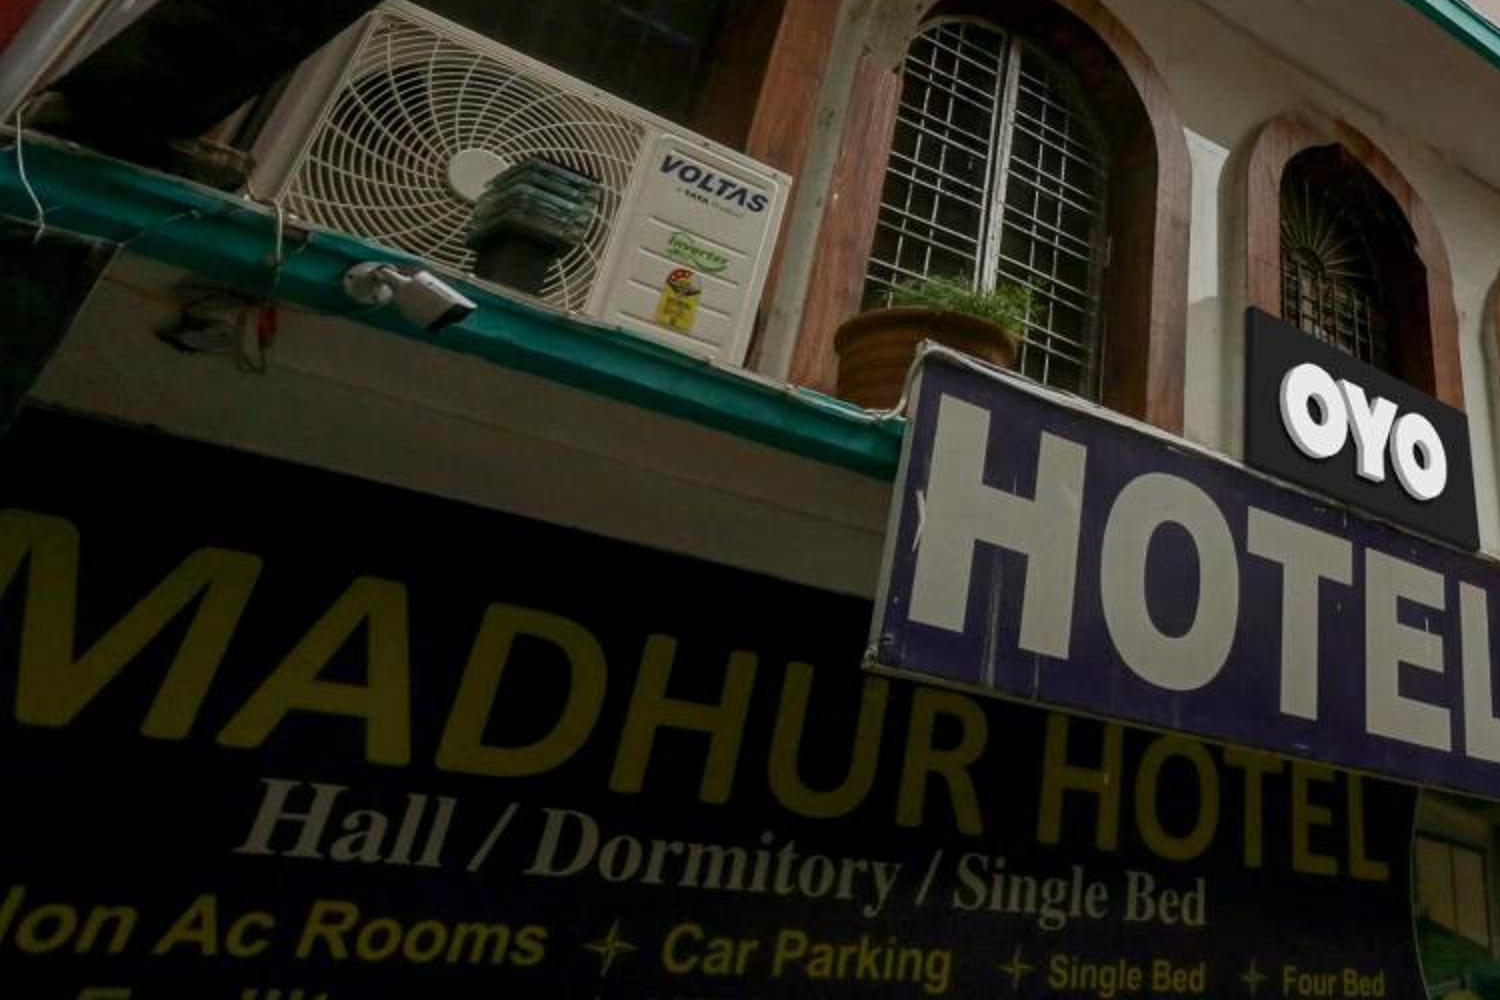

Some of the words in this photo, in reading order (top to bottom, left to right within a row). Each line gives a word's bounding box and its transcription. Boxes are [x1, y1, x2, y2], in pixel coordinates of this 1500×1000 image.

[659, 155, 769, 213] VOLTAS
[1279, 363, 1447, 500] OYO
[0, 507, 988, 838] MADHUR
[1035, 710, 1392, 882] HOTEL
[231, 776, 459, 871] Hall
[466, 802, 520, 873] /
[522, 806, 898, 918] Dormitory
[953, 855, 1111, 932] Single
[1123, 876, 1209, 928] Bed
[150, 890, 279, 960] Ac
[294, 898, 549, 968] Rooms
[660, 924, 758, 977] Car
[770, 928, 955, 994] Parking
[1047, 956, 1142, 997] Single
[1150, 961, 1208, 994] Bed
[1282, 965, 1338, 996] Four
[1341, 967, 1387, 998] Bed
